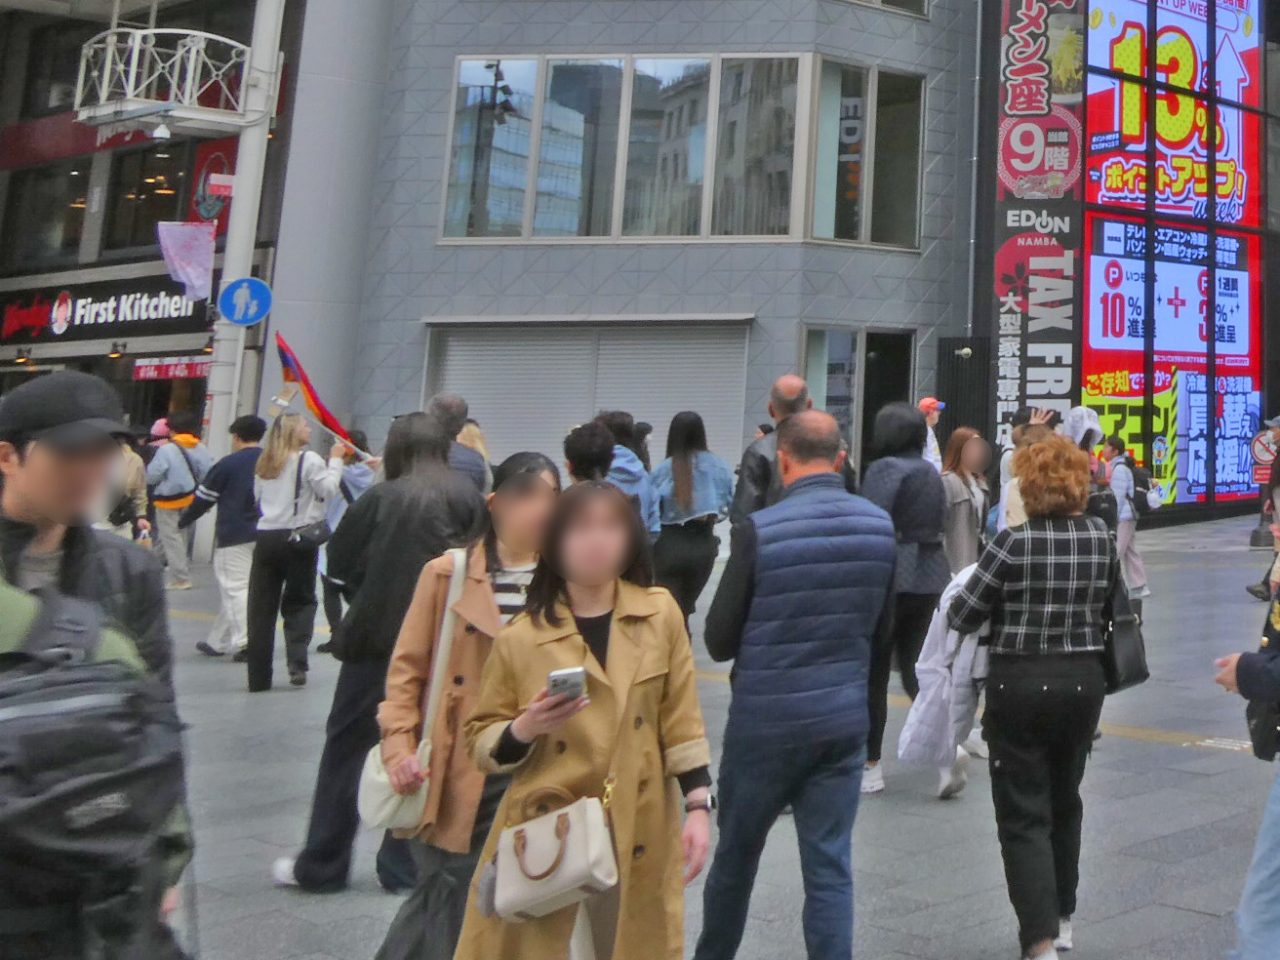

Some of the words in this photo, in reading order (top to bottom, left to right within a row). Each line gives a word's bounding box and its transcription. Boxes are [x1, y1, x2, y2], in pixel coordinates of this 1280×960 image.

[1007, 209, 1070, 234] EDION
[1017, 238, 1058, 247] NAMBA
[1028, 250, 1073, 333] TAX
[74, 297, 116, 325] First
[118, 291, 194, 322] Kitchen
